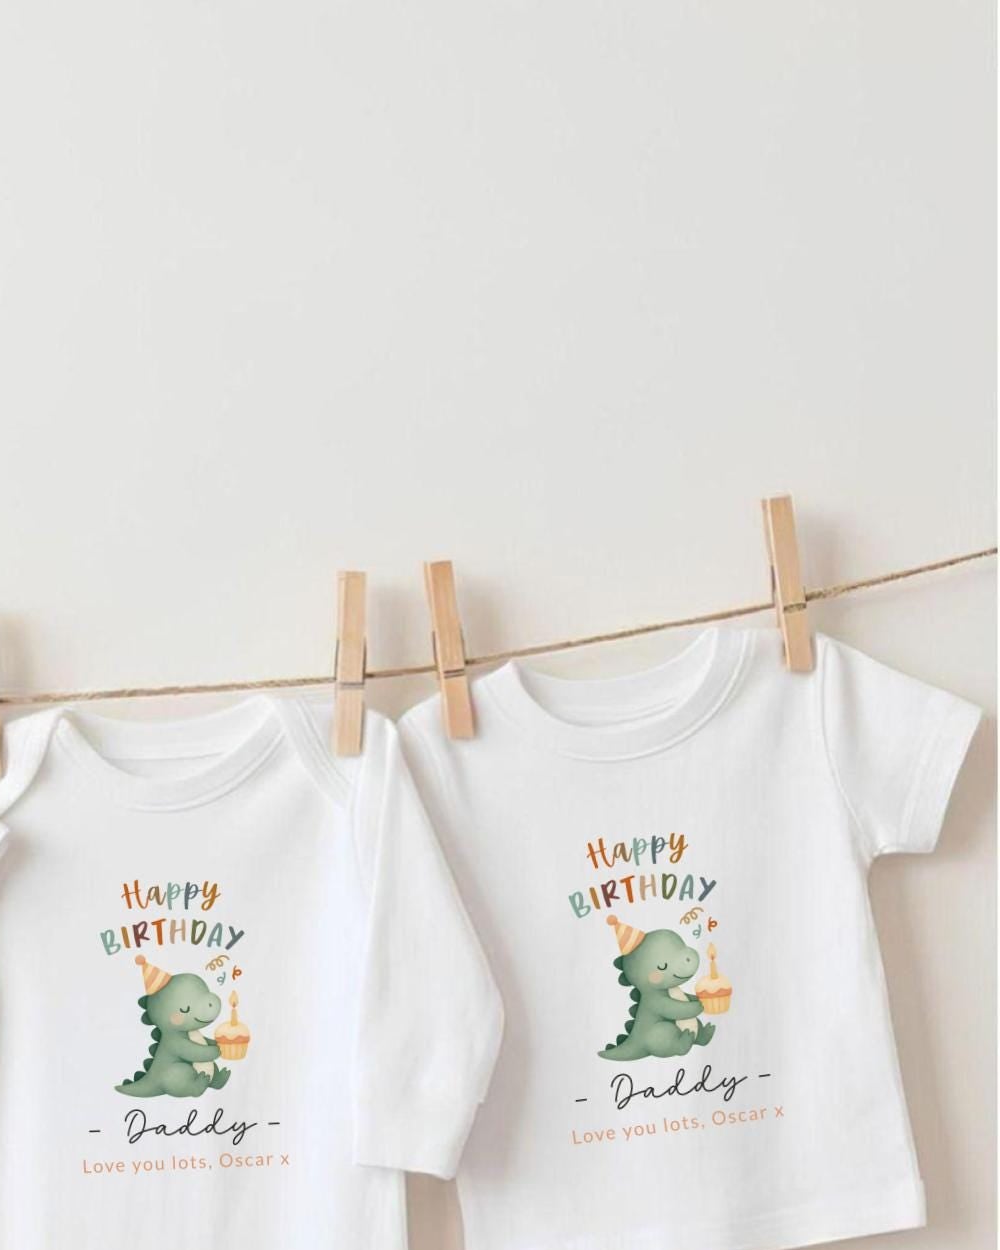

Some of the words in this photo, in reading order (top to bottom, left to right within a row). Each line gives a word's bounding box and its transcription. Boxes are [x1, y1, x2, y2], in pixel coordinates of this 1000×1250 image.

[586, 832, 689, 870] Happy
[120, 879, 222, 912] Happy
[568, 872, 718, 919] BIRTHDAY
[99, 917, 245, 956] BIRTHDAY
[610, 1064, 749, 1111] Daddy
[123, 1107, 259, 1146] Daddy
[572, 1129, 615, 1145] Love
[622, 1125, 656, 1141] you
[711, 1110, 767, 1127] Oscar
[83, 1159, 125, 1174] Love
[132, 1160, 165, 1176] you
[218, 1152, 273, 1169] Oscar
